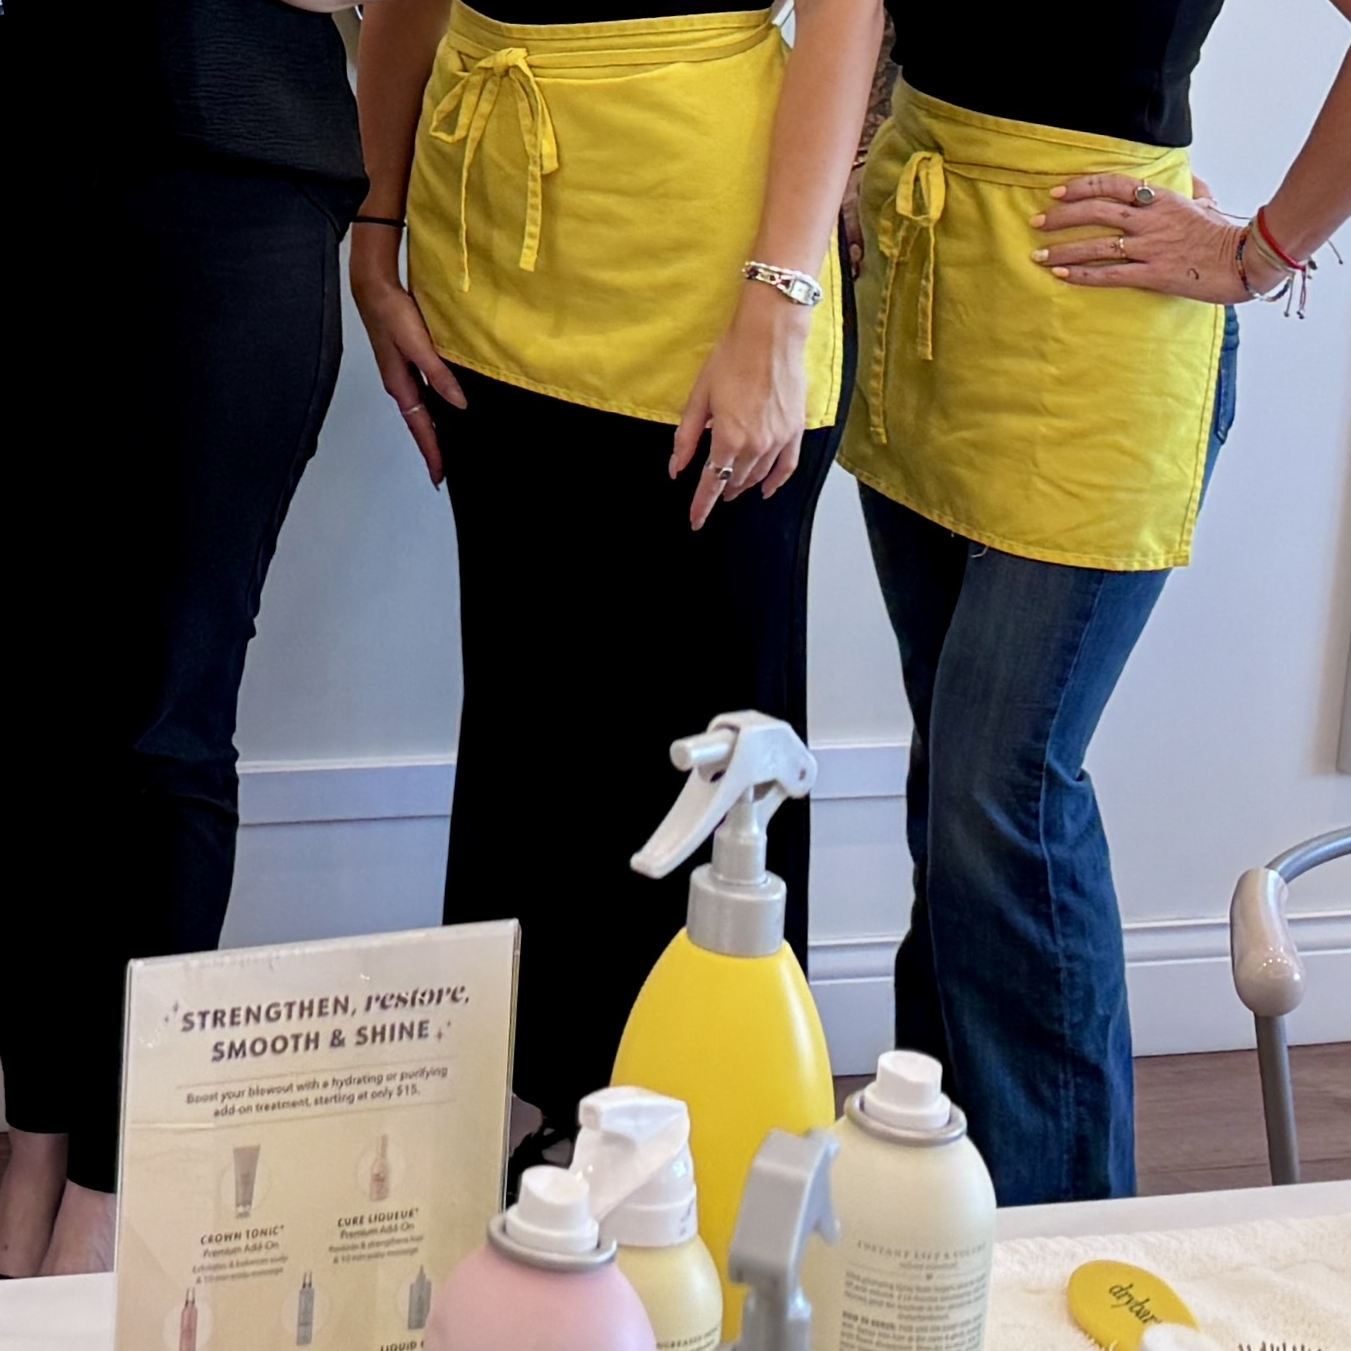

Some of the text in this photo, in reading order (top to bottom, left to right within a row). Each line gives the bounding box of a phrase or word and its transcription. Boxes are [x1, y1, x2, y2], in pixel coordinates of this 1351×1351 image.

[181, 985, 469, 1032] STRENGTHEN, restore,
[211, 1019, 430, 1062] SMOOTH & SHINE
[187, 1092, 218, 1104] Boost
[221, 1090, 245, 1103] your
[248, 1082, 293, 1098] blowout
[296, 1077, 319, 1092] with
[331, 1073, 384, 1089] hydrating
[386, 1072, 397, 1082] or
[400, 1066, 448, 1081] purifying
[314, 1091, 355, 1105] starting
[357, 1090, 368, 1101] at
[370, 1086, 393, 1100] only
[200, 1231, 242, 1245] CROWN
[338, 1215, 364, 1227] CURE
[1108, 1283, 1159, 1324] drybar
